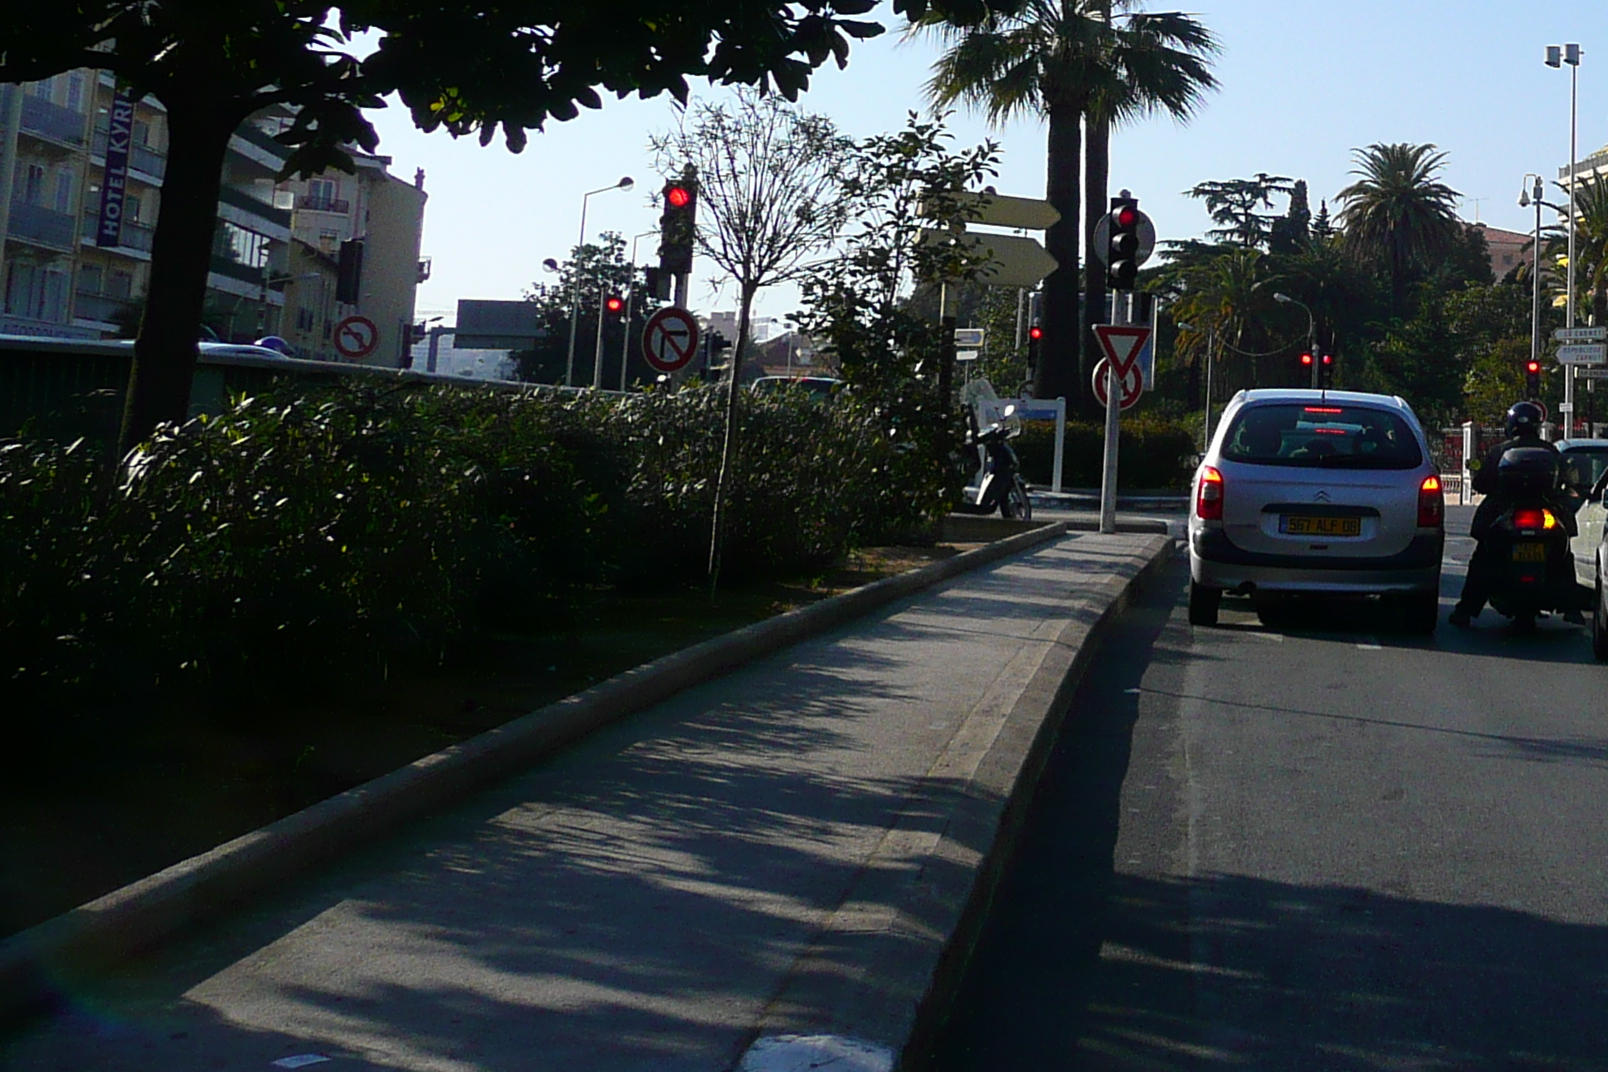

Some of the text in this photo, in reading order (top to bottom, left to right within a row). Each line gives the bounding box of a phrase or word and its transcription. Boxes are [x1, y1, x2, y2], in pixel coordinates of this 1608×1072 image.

[102, 166, 126, 237] HOTEL
[1316, 519, 1338, 532] ALF
[1342, 519, 1358, 533] 06
